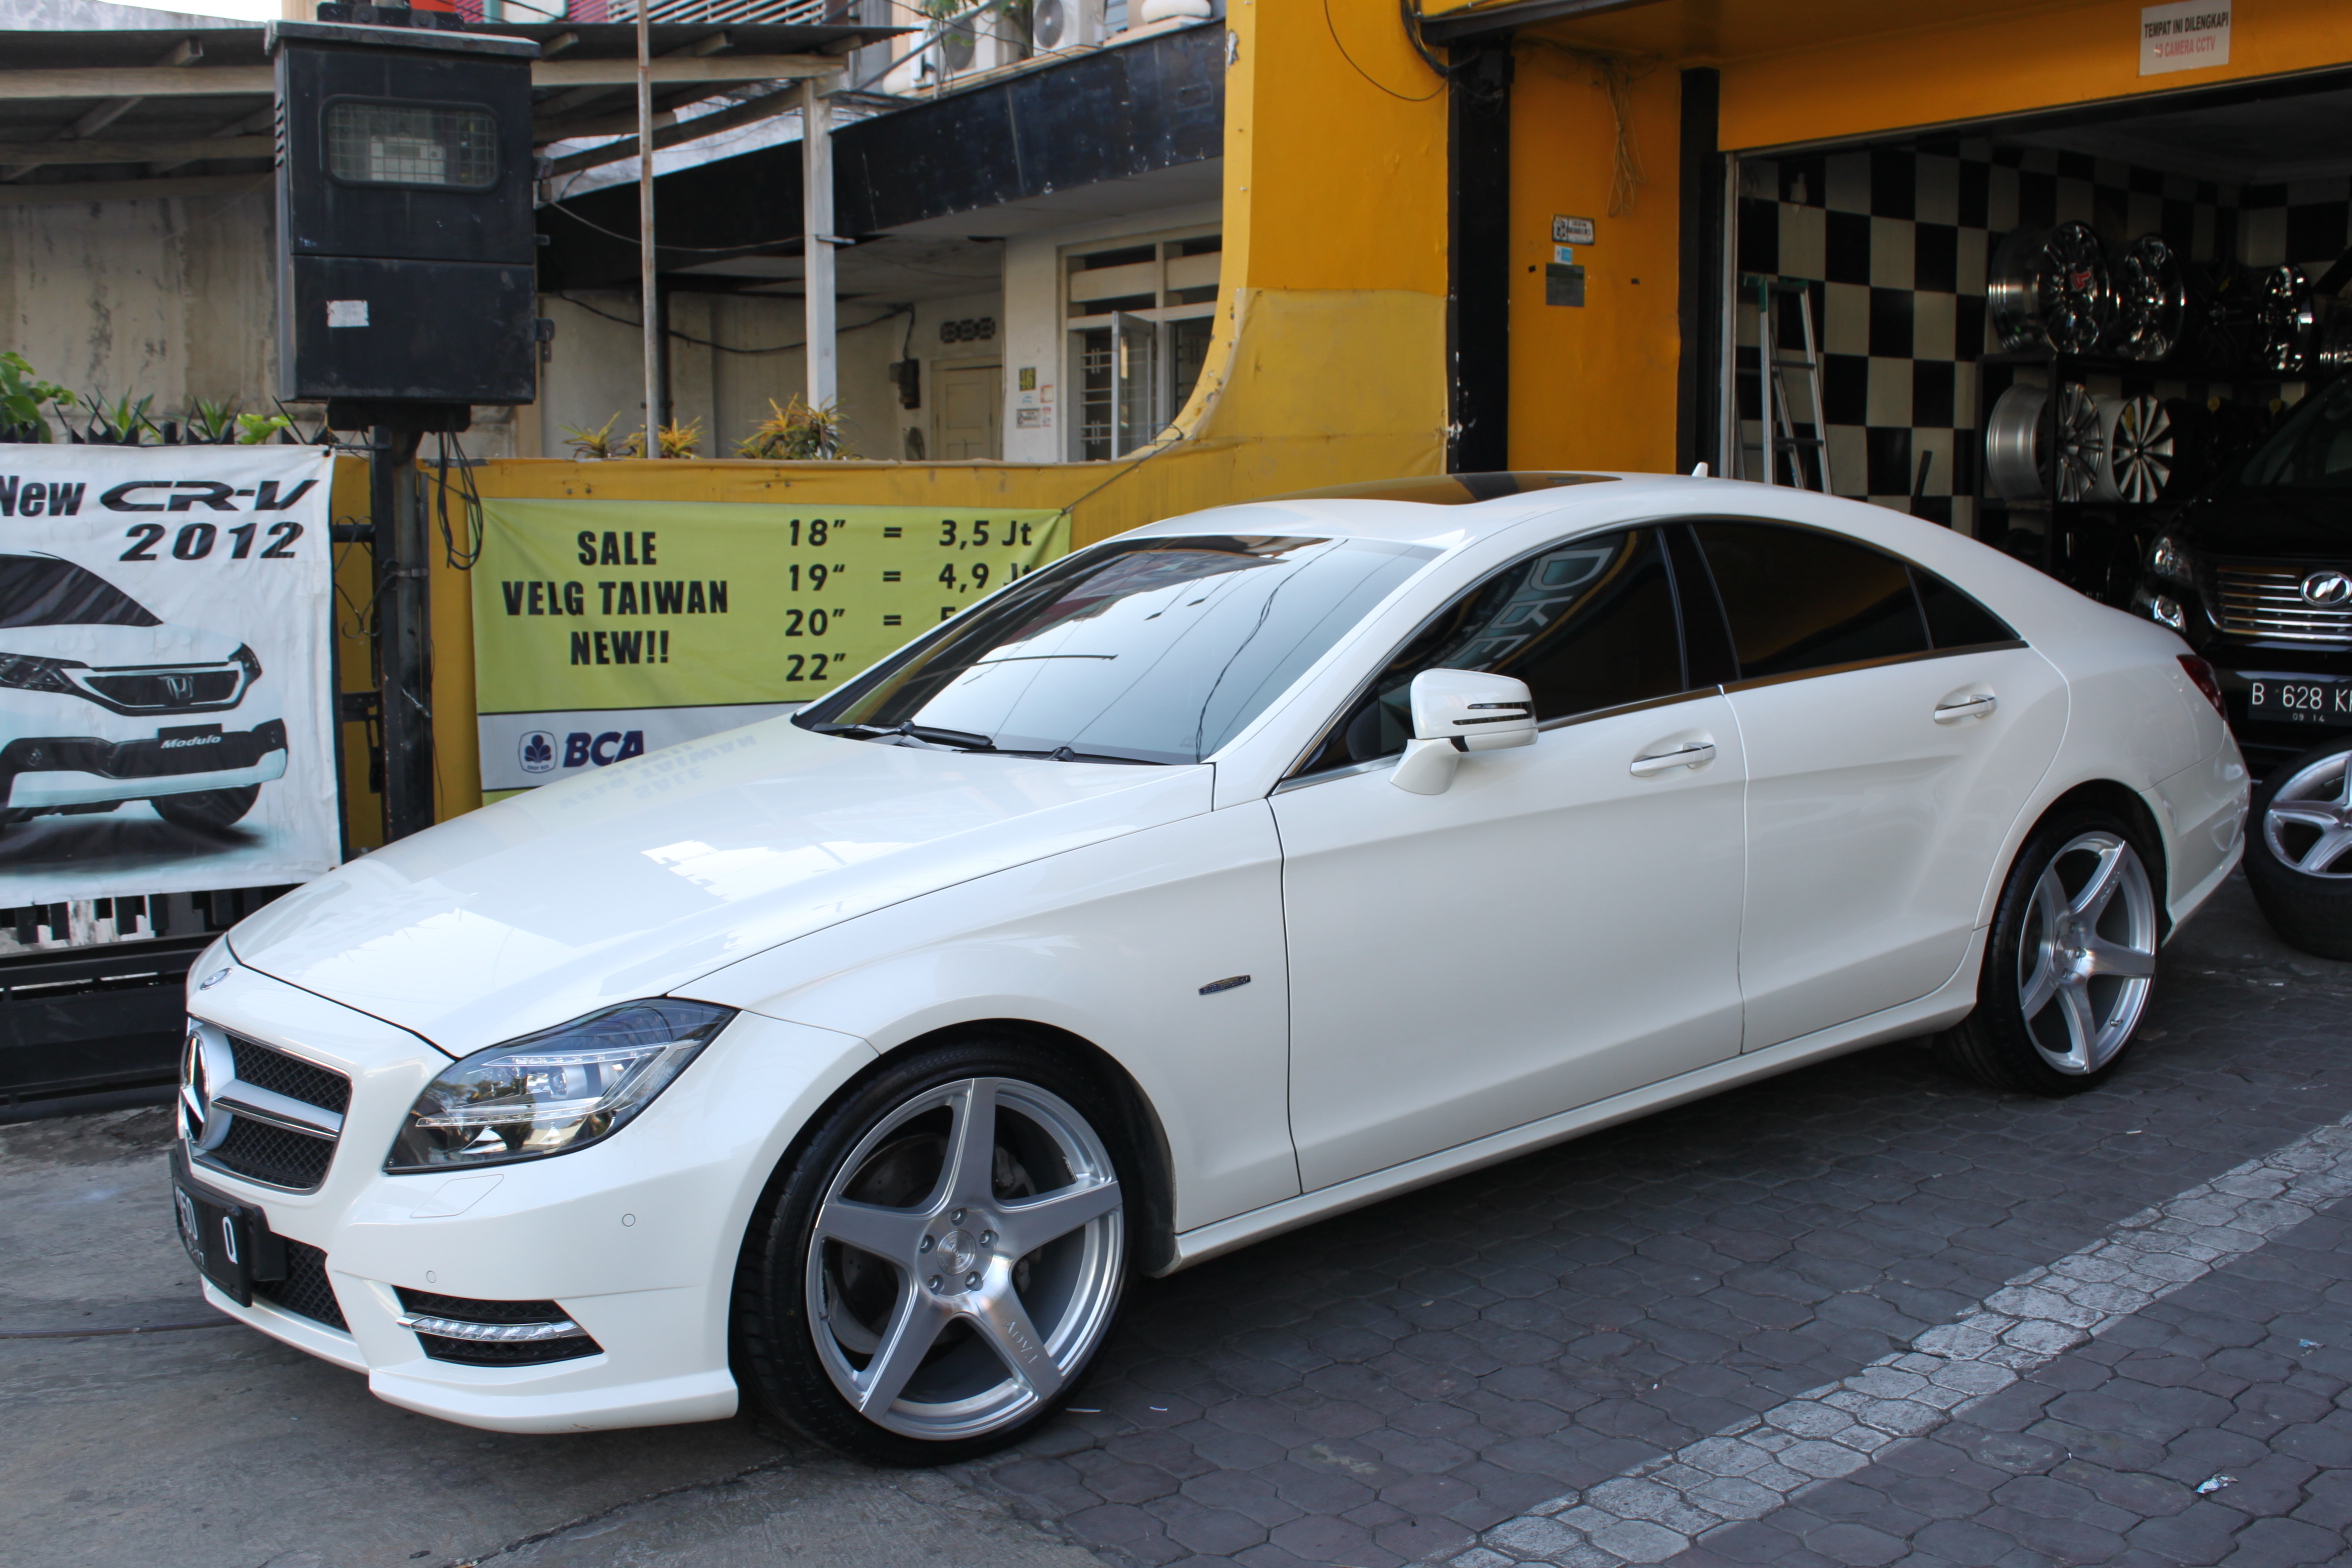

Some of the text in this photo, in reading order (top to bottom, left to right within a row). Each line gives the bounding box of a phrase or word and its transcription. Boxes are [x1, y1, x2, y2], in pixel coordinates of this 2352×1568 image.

[2144, 11, 2229, 38] TEMPAT INI DILENGKAPI
[2165, 38, 2194, 57] CAMERA
[2196, 35, 2216, 53] CCTV
[0, 475, 320, 517] New CR-V
[119, 522, 304, 561] 2012
[577, 530, 657, 566] SALE
[789, 519, 1032, 550] 18" = 3,5 Jt
[882, 571, 901, 582] =
[938, 563, 989, 593] 4,9
[501, 580, 728, 616] VELG TAIWAN
[785, 608, 902, 637] 20" =
[570, 630, 669, 666] NEW!!
[786, 653, 846, 682] 22"
[2252, 682, 2352, 713] B 628 K
[160, 734, 222, 749] Modulo
[562, 730, 645, 767] BCA
[222, 1215, 238, 1264] Q
